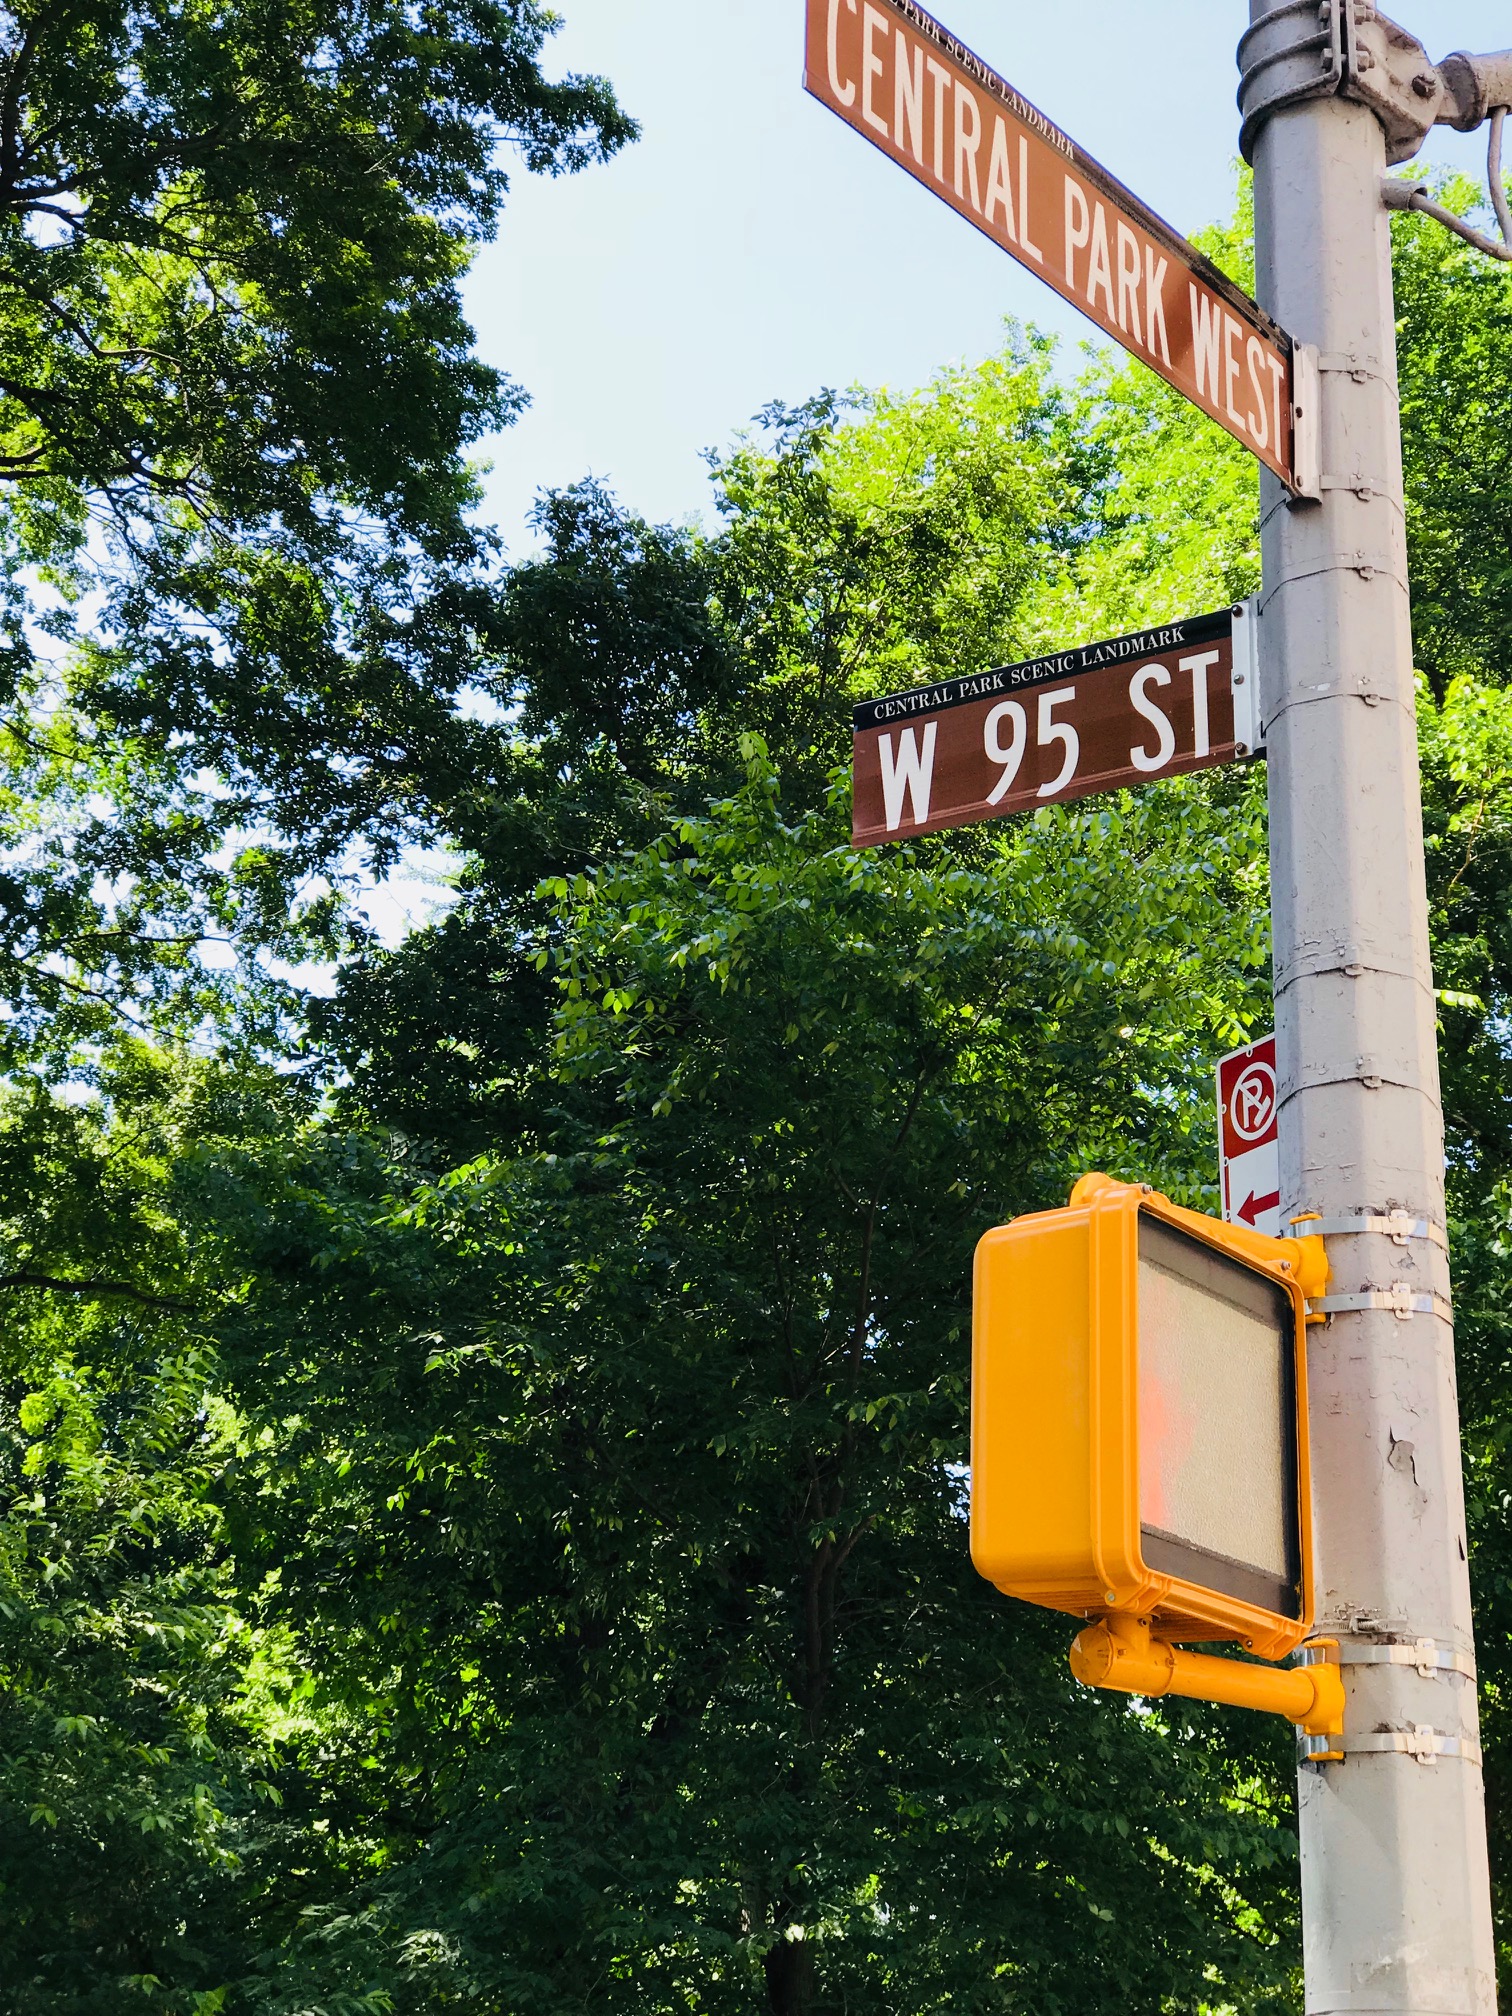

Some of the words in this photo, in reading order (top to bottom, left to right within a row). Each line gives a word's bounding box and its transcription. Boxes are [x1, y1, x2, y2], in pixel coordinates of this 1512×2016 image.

[903, 0, 941, 43] PARK
[945, 35, 997, 90] SCENIC
[1000, 83, 1075, 160] LANDMARK
[827, 0, 1043, 264] CENTRAL
[1064, 173, 1174, 371] PARK
[1189, 281, 1285, 466] WEST
[873, 687, 953, 721] CENTRAL
[959, 673, 1004, 698] PARK
[1010, 655, 1075, 685] SCENIC
[1081, 626, 1186, 667] LANDMARK
[878, 721, 938, 832] W
[983, 686, 1080, 807] 95
[1129, 649, 1220, 772] ST
